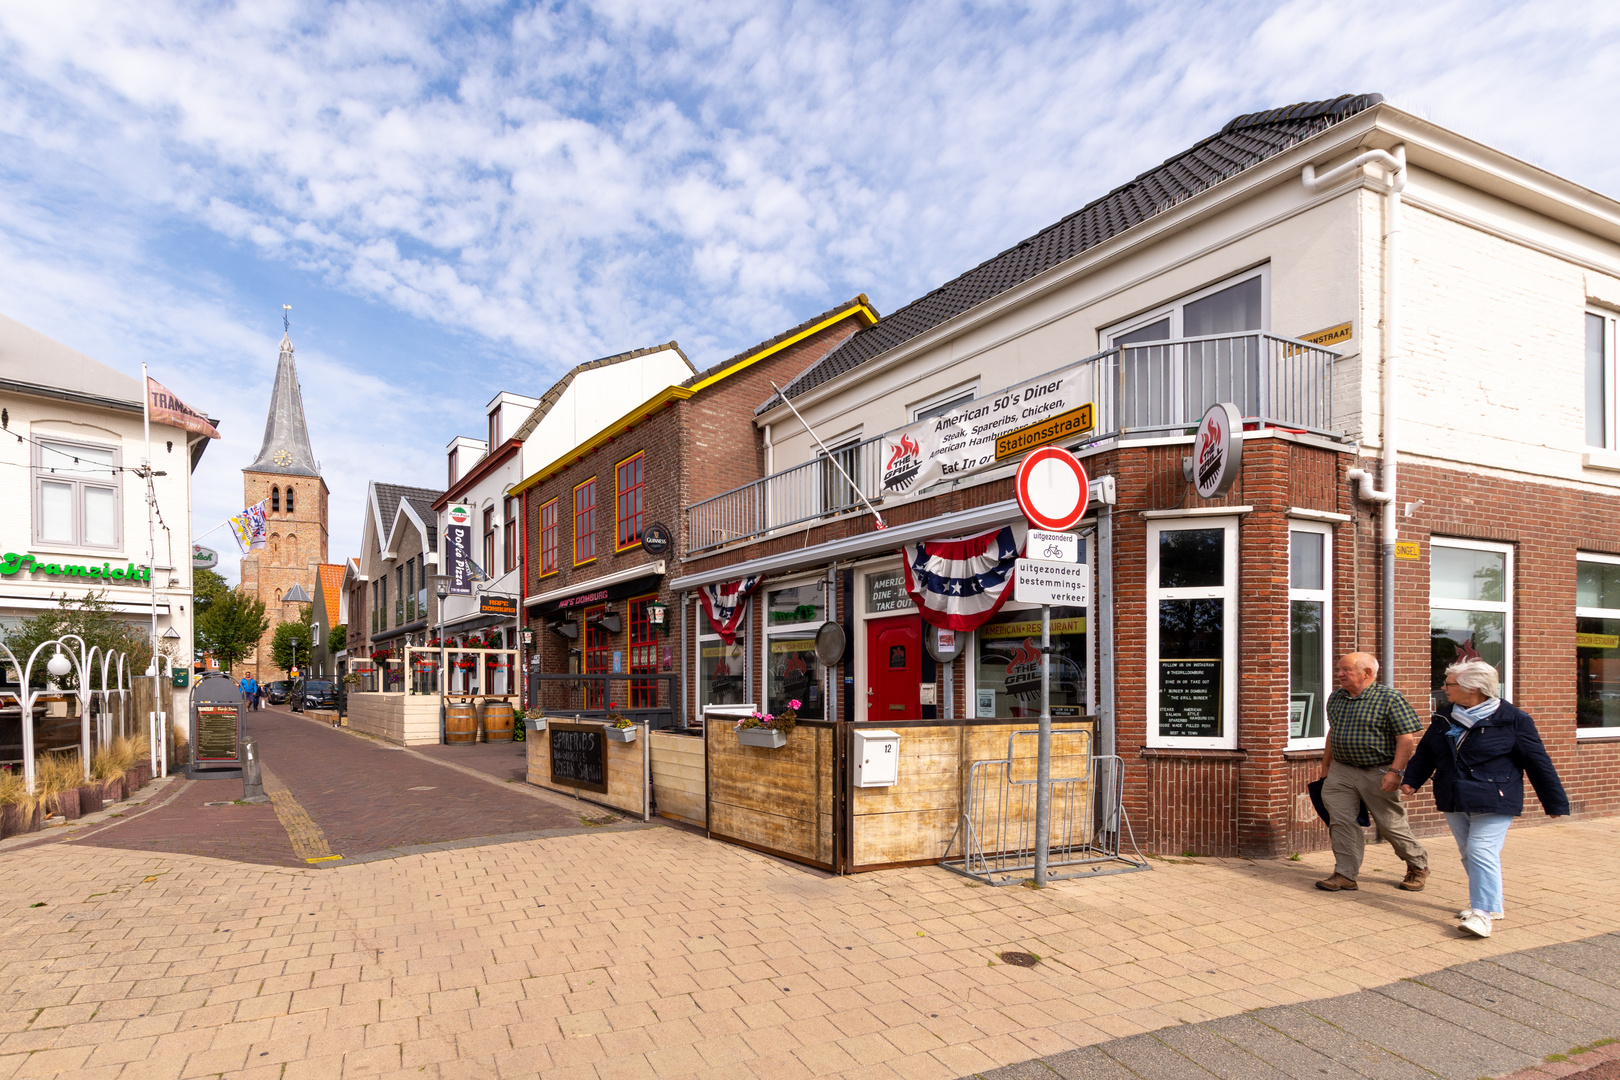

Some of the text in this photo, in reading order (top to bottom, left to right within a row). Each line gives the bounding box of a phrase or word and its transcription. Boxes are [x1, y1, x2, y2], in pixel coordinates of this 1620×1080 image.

[935, 379, 1064, 432] American 50's Diner
[942, 428, 968, 444] Steak,
[971, 414, 1019, 436] Spareribs,
[1021, 399, 1066, 419] Chicken,
[999, 413, 1087, 453] Stationsstraat
[929, 440, 966, 459] American
[1204, 443, 1215, 460] THE
[893, 454, 911, 468] THE
[942, 455, 994, 475] Eat In or
[1199, 449, 1223, 478] GRILL
[884, 459, 923, 480] GRILL
[1033, 532, 1073, 542] uitgezonderd
[1397, 545, 1418, 556] SINGEL
[0, 553, 152, 581] Tramzicht
[455, 559, 465, 586] Pizza
[1020, 564, 1081, 576] uitgezonderd
[1019, 576, 1086, 591] bestemmings-
[575, 590, 608, 605] DOMBURG
[873, 590, 892, 601] DINE
[1051, 593, 1086, 602] verkeer
[876, 599, 913, 611] TAKE OUT
[985, 621, 1079, 635] AMERICAN RESAURANT
[1015, 663, 1037, 673] THE
[1005, 672, 1052, 684] GRIL
[885, 744, 892, 754] 12
